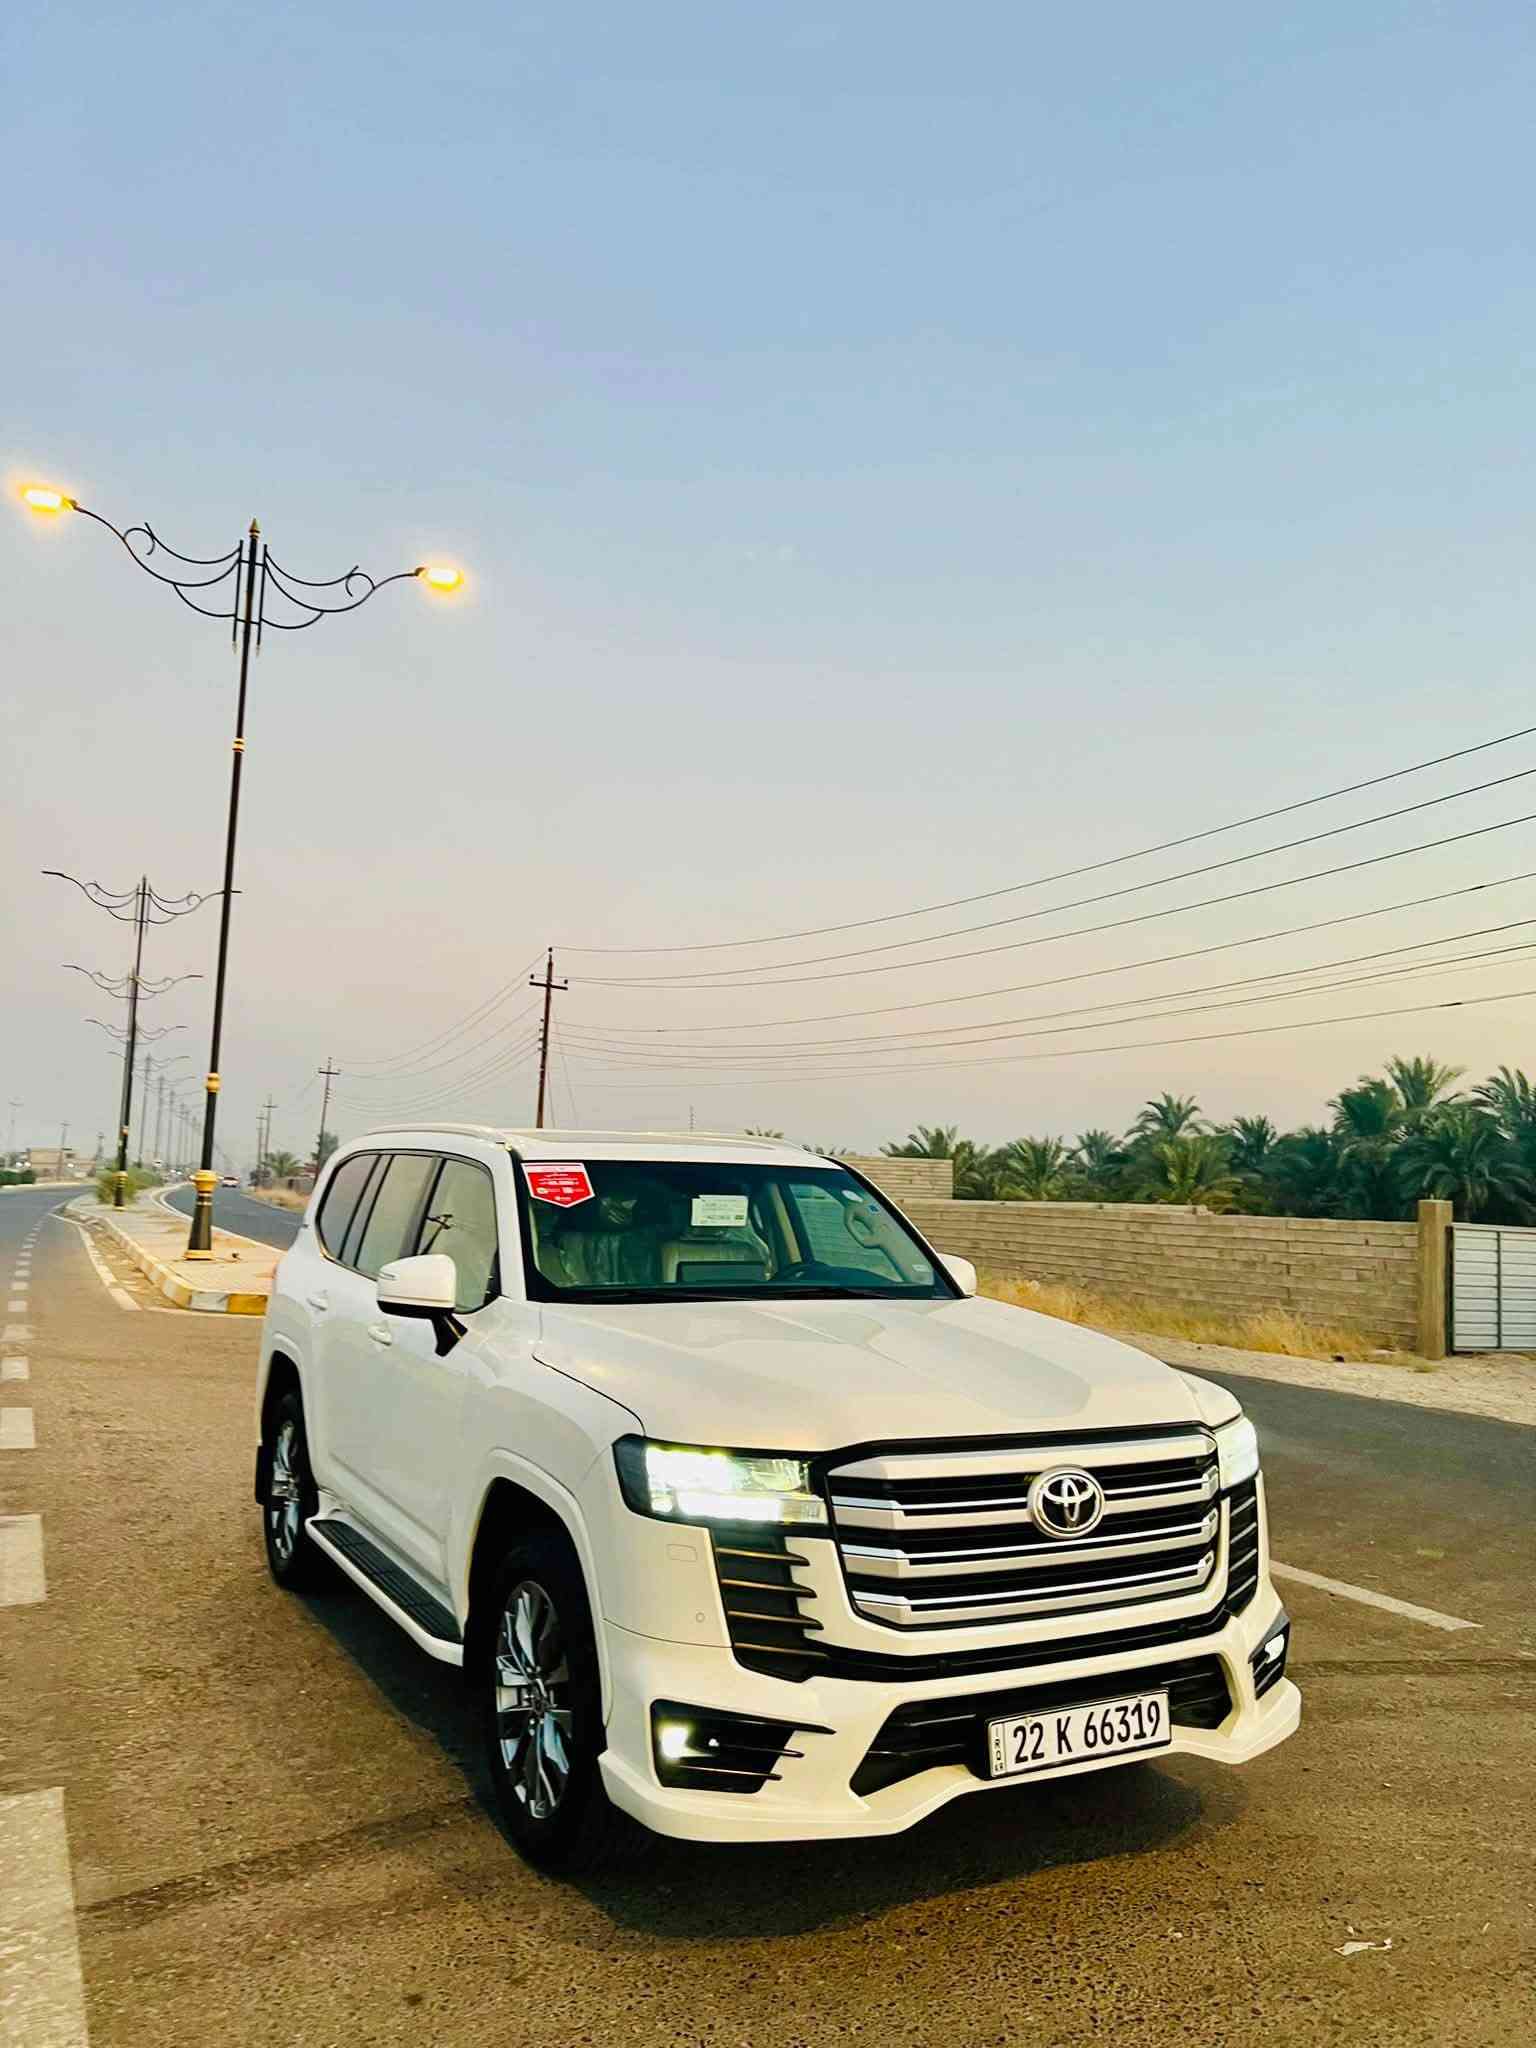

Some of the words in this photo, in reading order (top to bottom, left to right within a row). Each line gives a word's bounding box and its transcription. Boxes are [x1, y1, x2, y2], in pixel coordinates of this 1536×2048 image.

[1013, 1722, 1045, 1764] 22
[1056, 1716, 1073, 1755] K
[1084, 1700, 1160, 1749] 66319
